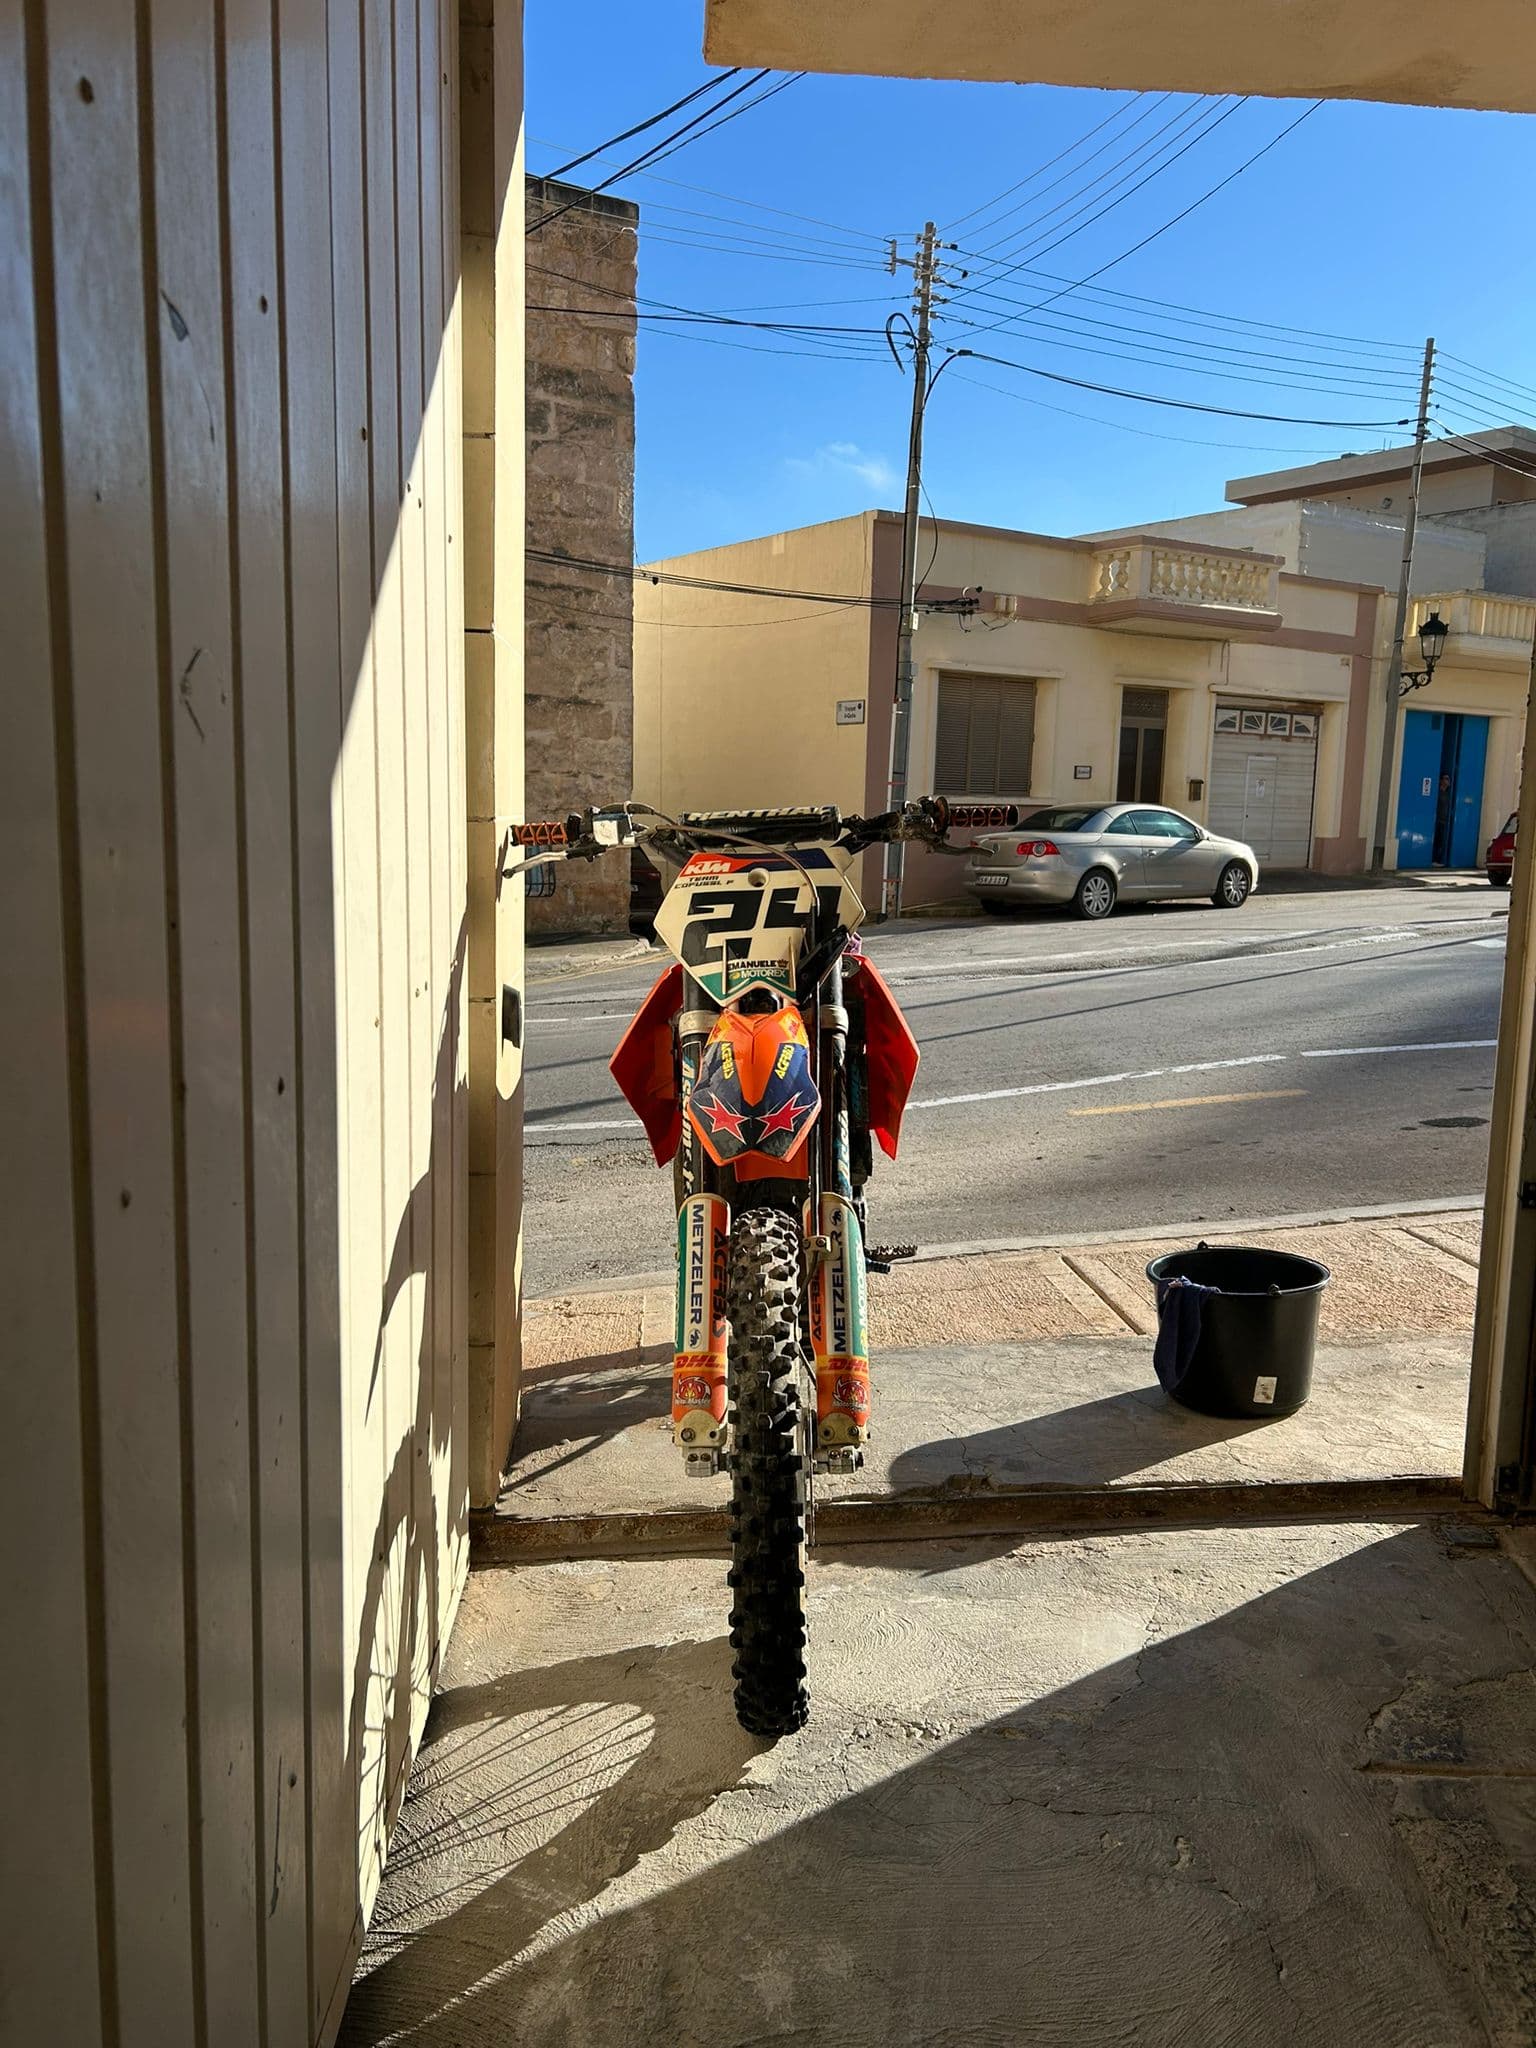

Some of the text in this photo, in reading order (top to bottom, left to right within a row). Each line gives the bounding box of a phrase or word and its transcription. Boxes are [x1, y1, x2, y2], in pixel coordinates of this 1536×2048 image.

[683, 860, 731, 876] KTM
[680, 886, 843, 967] 24
[727, 959, 777, 971] EMANUELE
[741, 969, 785, 979] MOTOREX
[690, 1203, 704, 1325] METZELER
[675, 1354, 720, 1368] DHL
